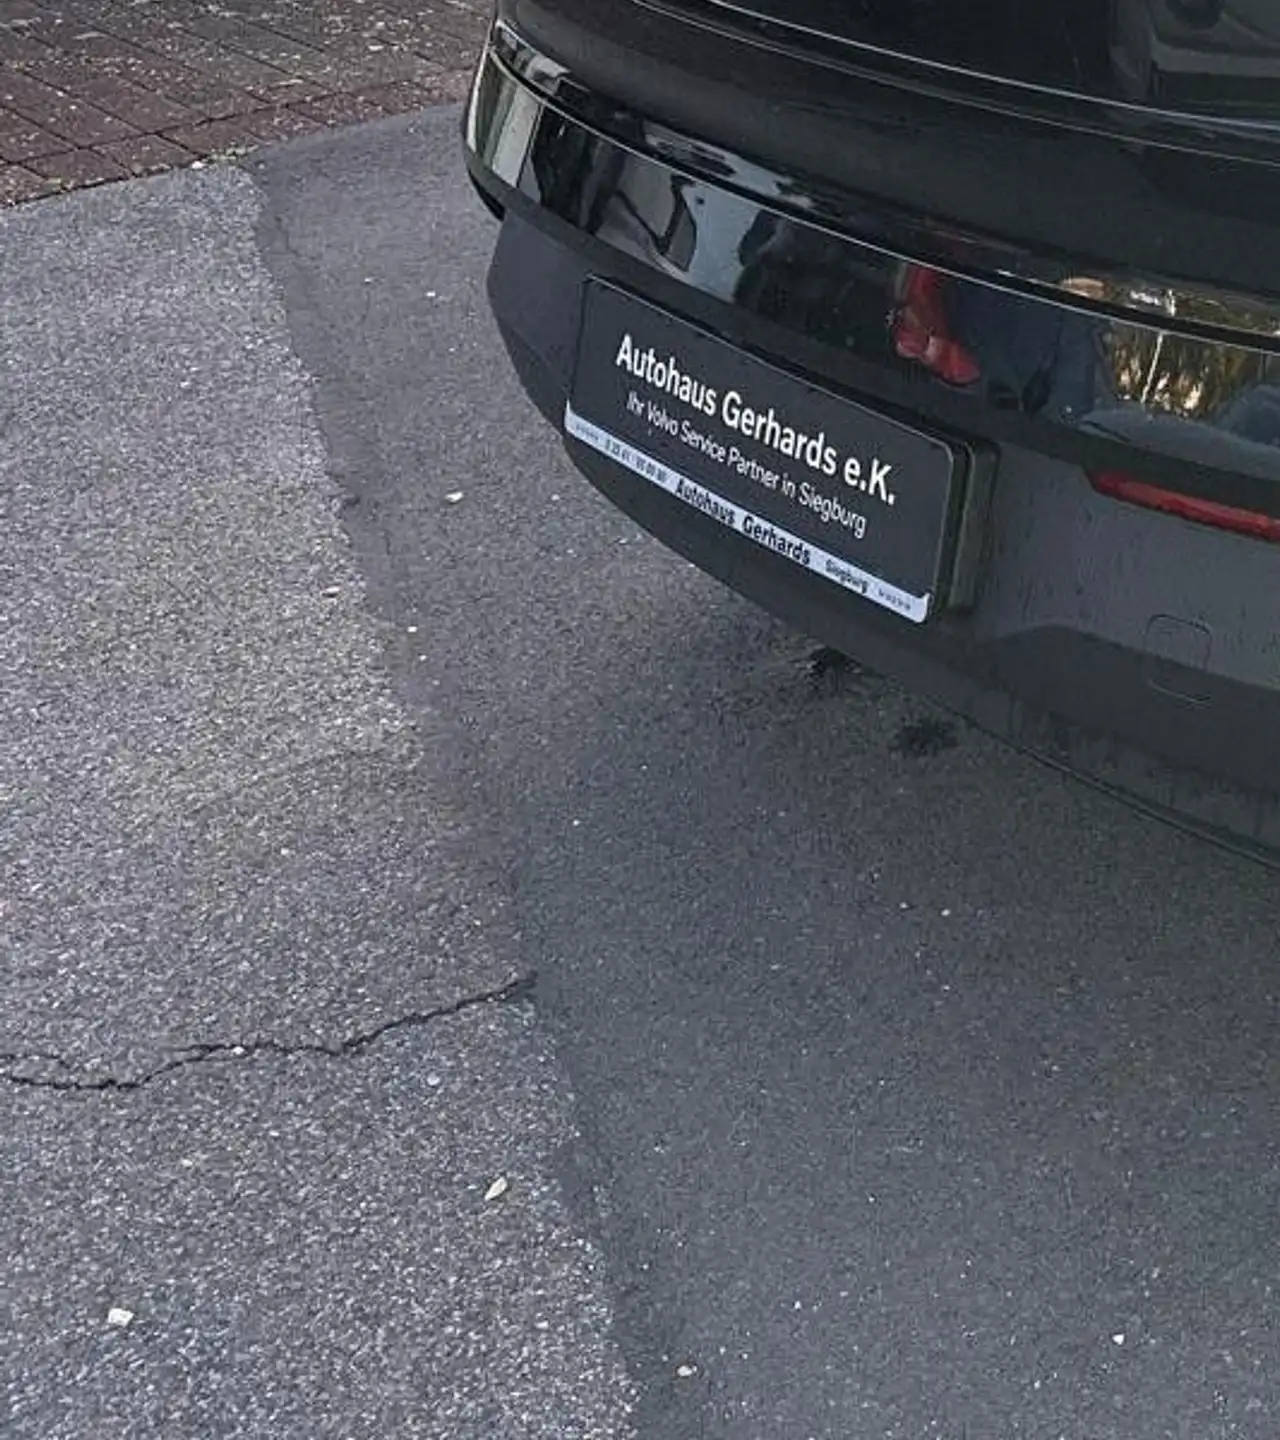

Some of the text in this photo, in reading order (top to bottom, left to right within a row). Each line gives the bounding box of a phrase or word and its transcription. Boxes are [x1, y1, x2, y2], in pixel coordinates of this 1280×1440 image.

[616, 333, 717, 417] Autohaus
[722, 390, 837, 476] Gerhards
[844, 457, 896, 505] e.K.
[627, 390, 645, 416] Ihr
[648, 401, 679, 436] Volvo
[681, 420, 726, 463] Service
[728, 446, 780, 489] Partner
[782, 472, 796, 498] in
[799, 482, 867, 539] Siegburg
[675, 478, 736, 526] Autohaus
[742, 515, 811, 565] Gerhards
